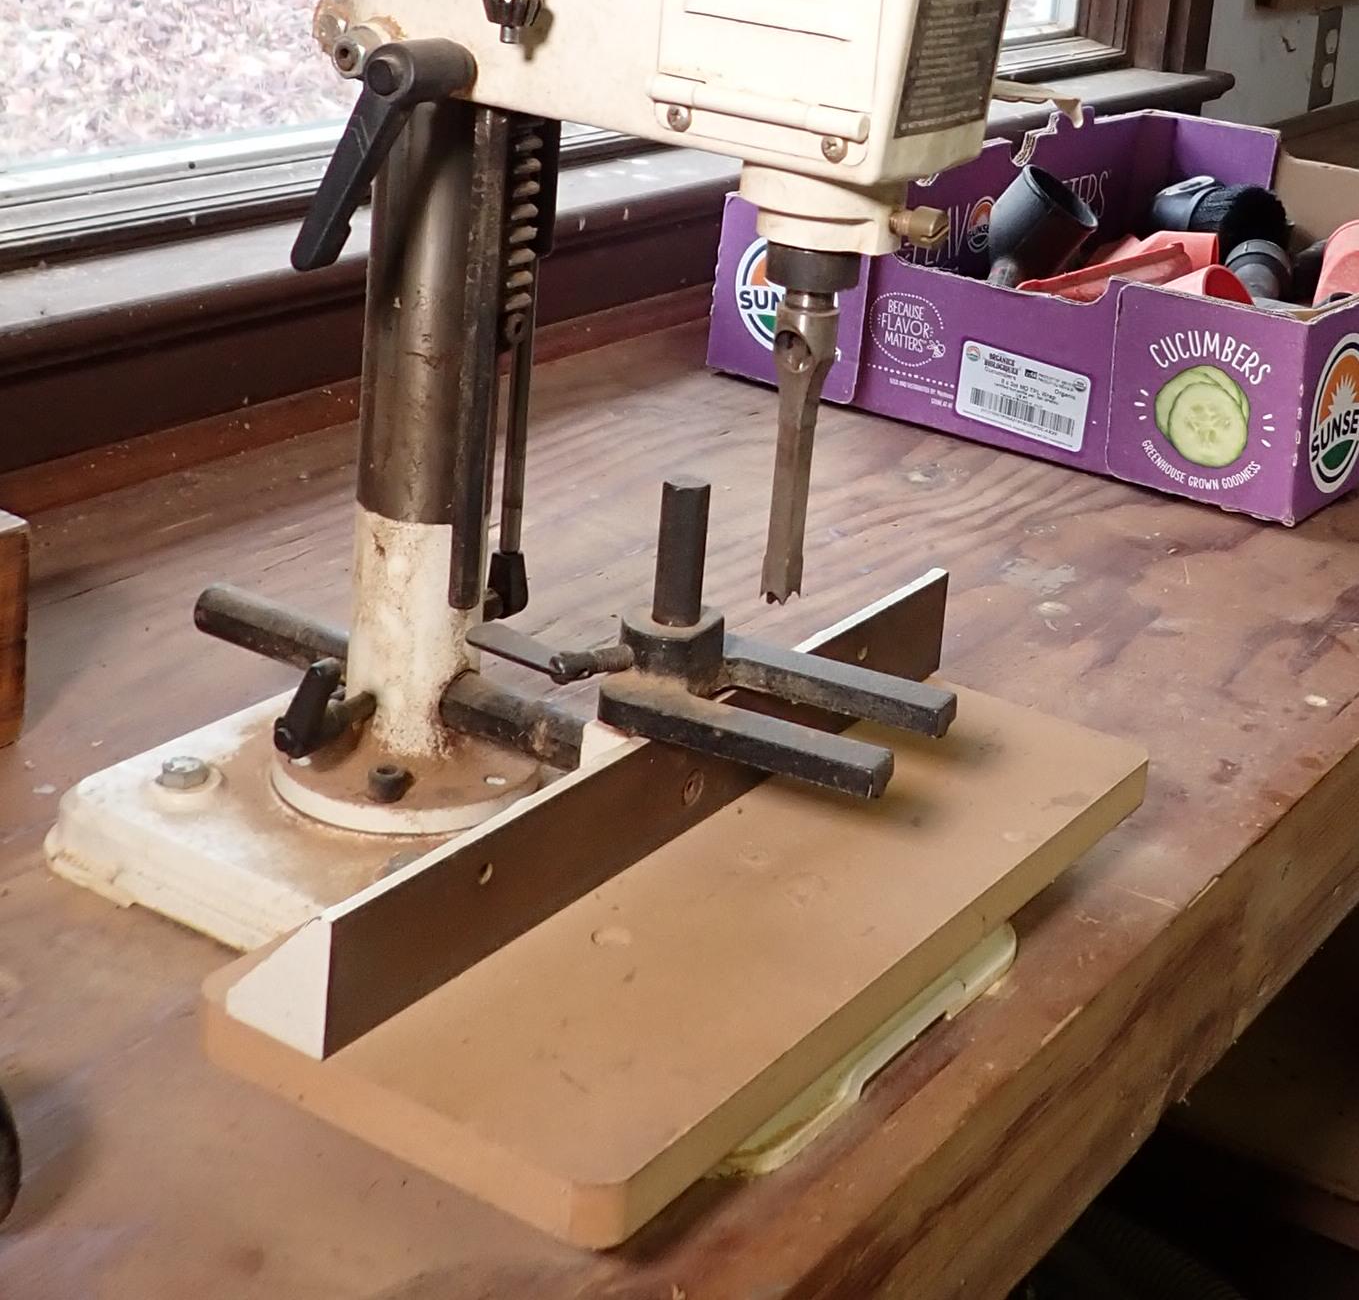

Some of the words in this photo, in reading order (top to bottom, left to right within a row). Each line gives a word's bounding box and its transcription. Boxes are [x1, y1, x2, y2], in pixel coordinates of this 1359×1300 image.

[739, 288, 786, 311] SUN
[888, 299, 925, 321] BECAUSE
[881, 312, 930, 339] FLAVOR
[884, 330, 924, 353] MATTERS
[1149, 330, 1271, 385] CUCUMBERS
[1310, 409, 1359, 463] SUNSE
[1142, 439, 1187, 484] GREENHOUSE
[1188, 475, 1220, 490] GROWN
[1221, 460, 1261, 490] GOODNESS
